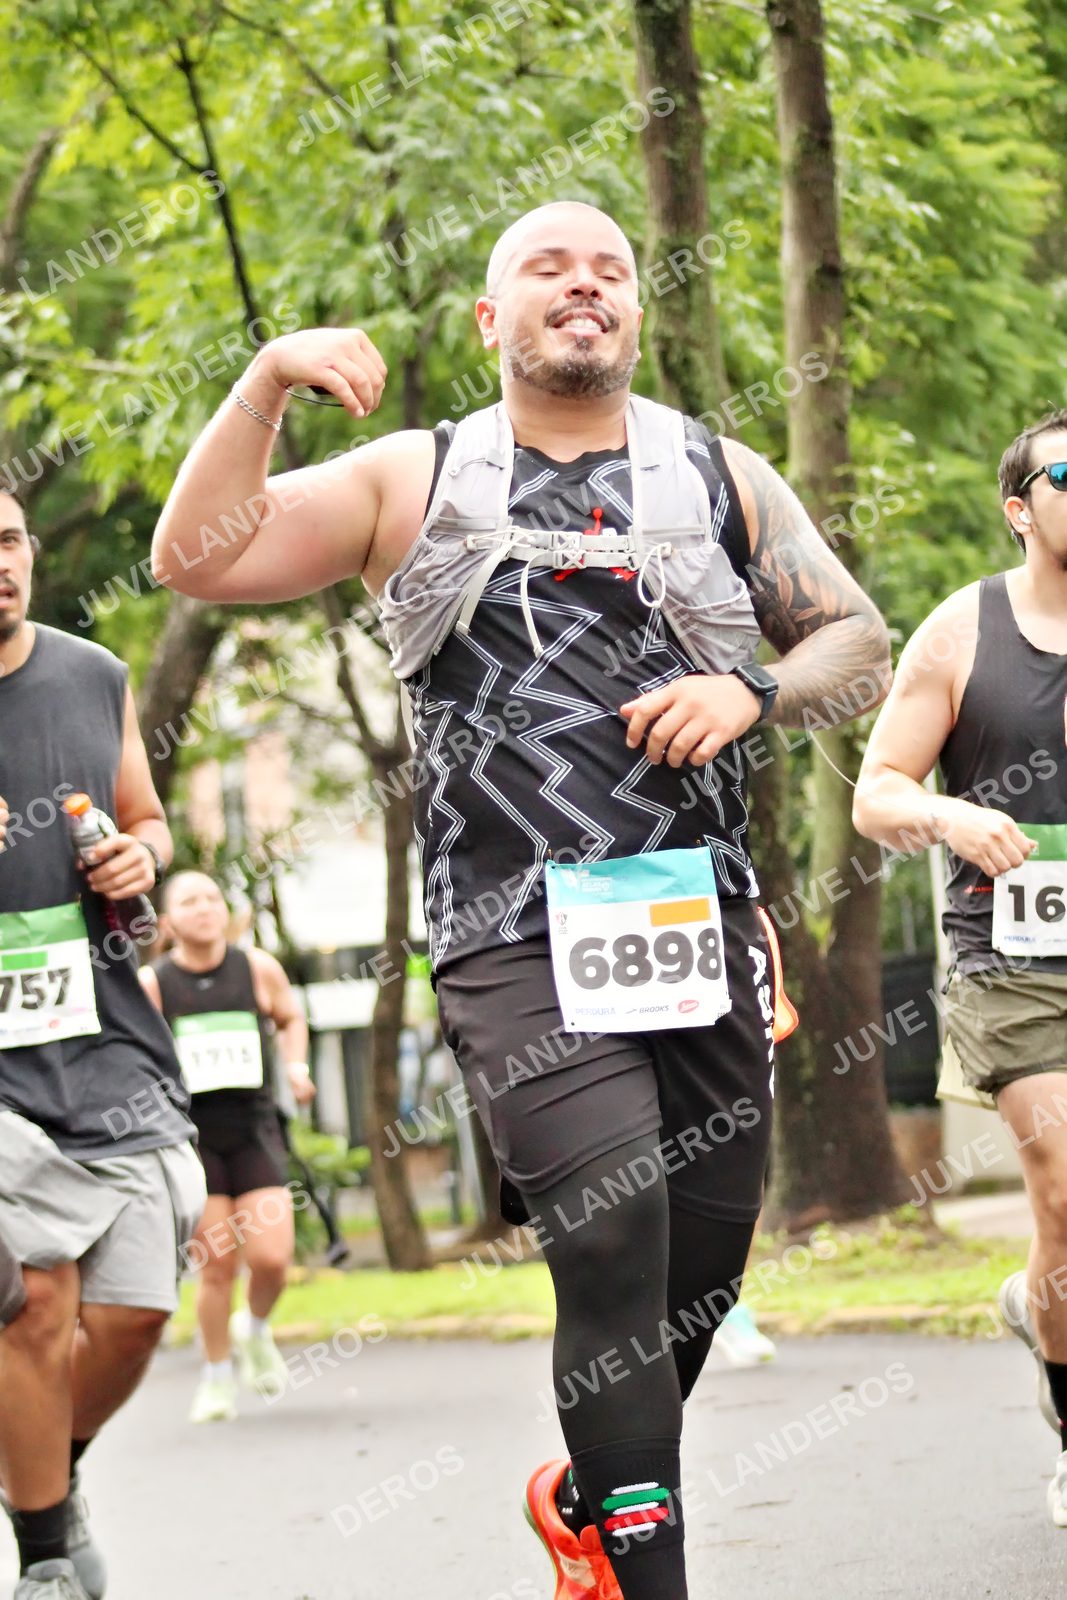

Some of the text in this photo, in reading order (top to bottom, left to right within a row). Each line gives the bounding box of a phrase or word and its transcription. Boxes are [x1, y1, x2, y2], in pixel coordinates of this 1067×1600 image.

[1008, 884, 1066, 923] 16
[569, 928, 722, 990] 6898
[639, 1005, 669, 1014] BROOKS
